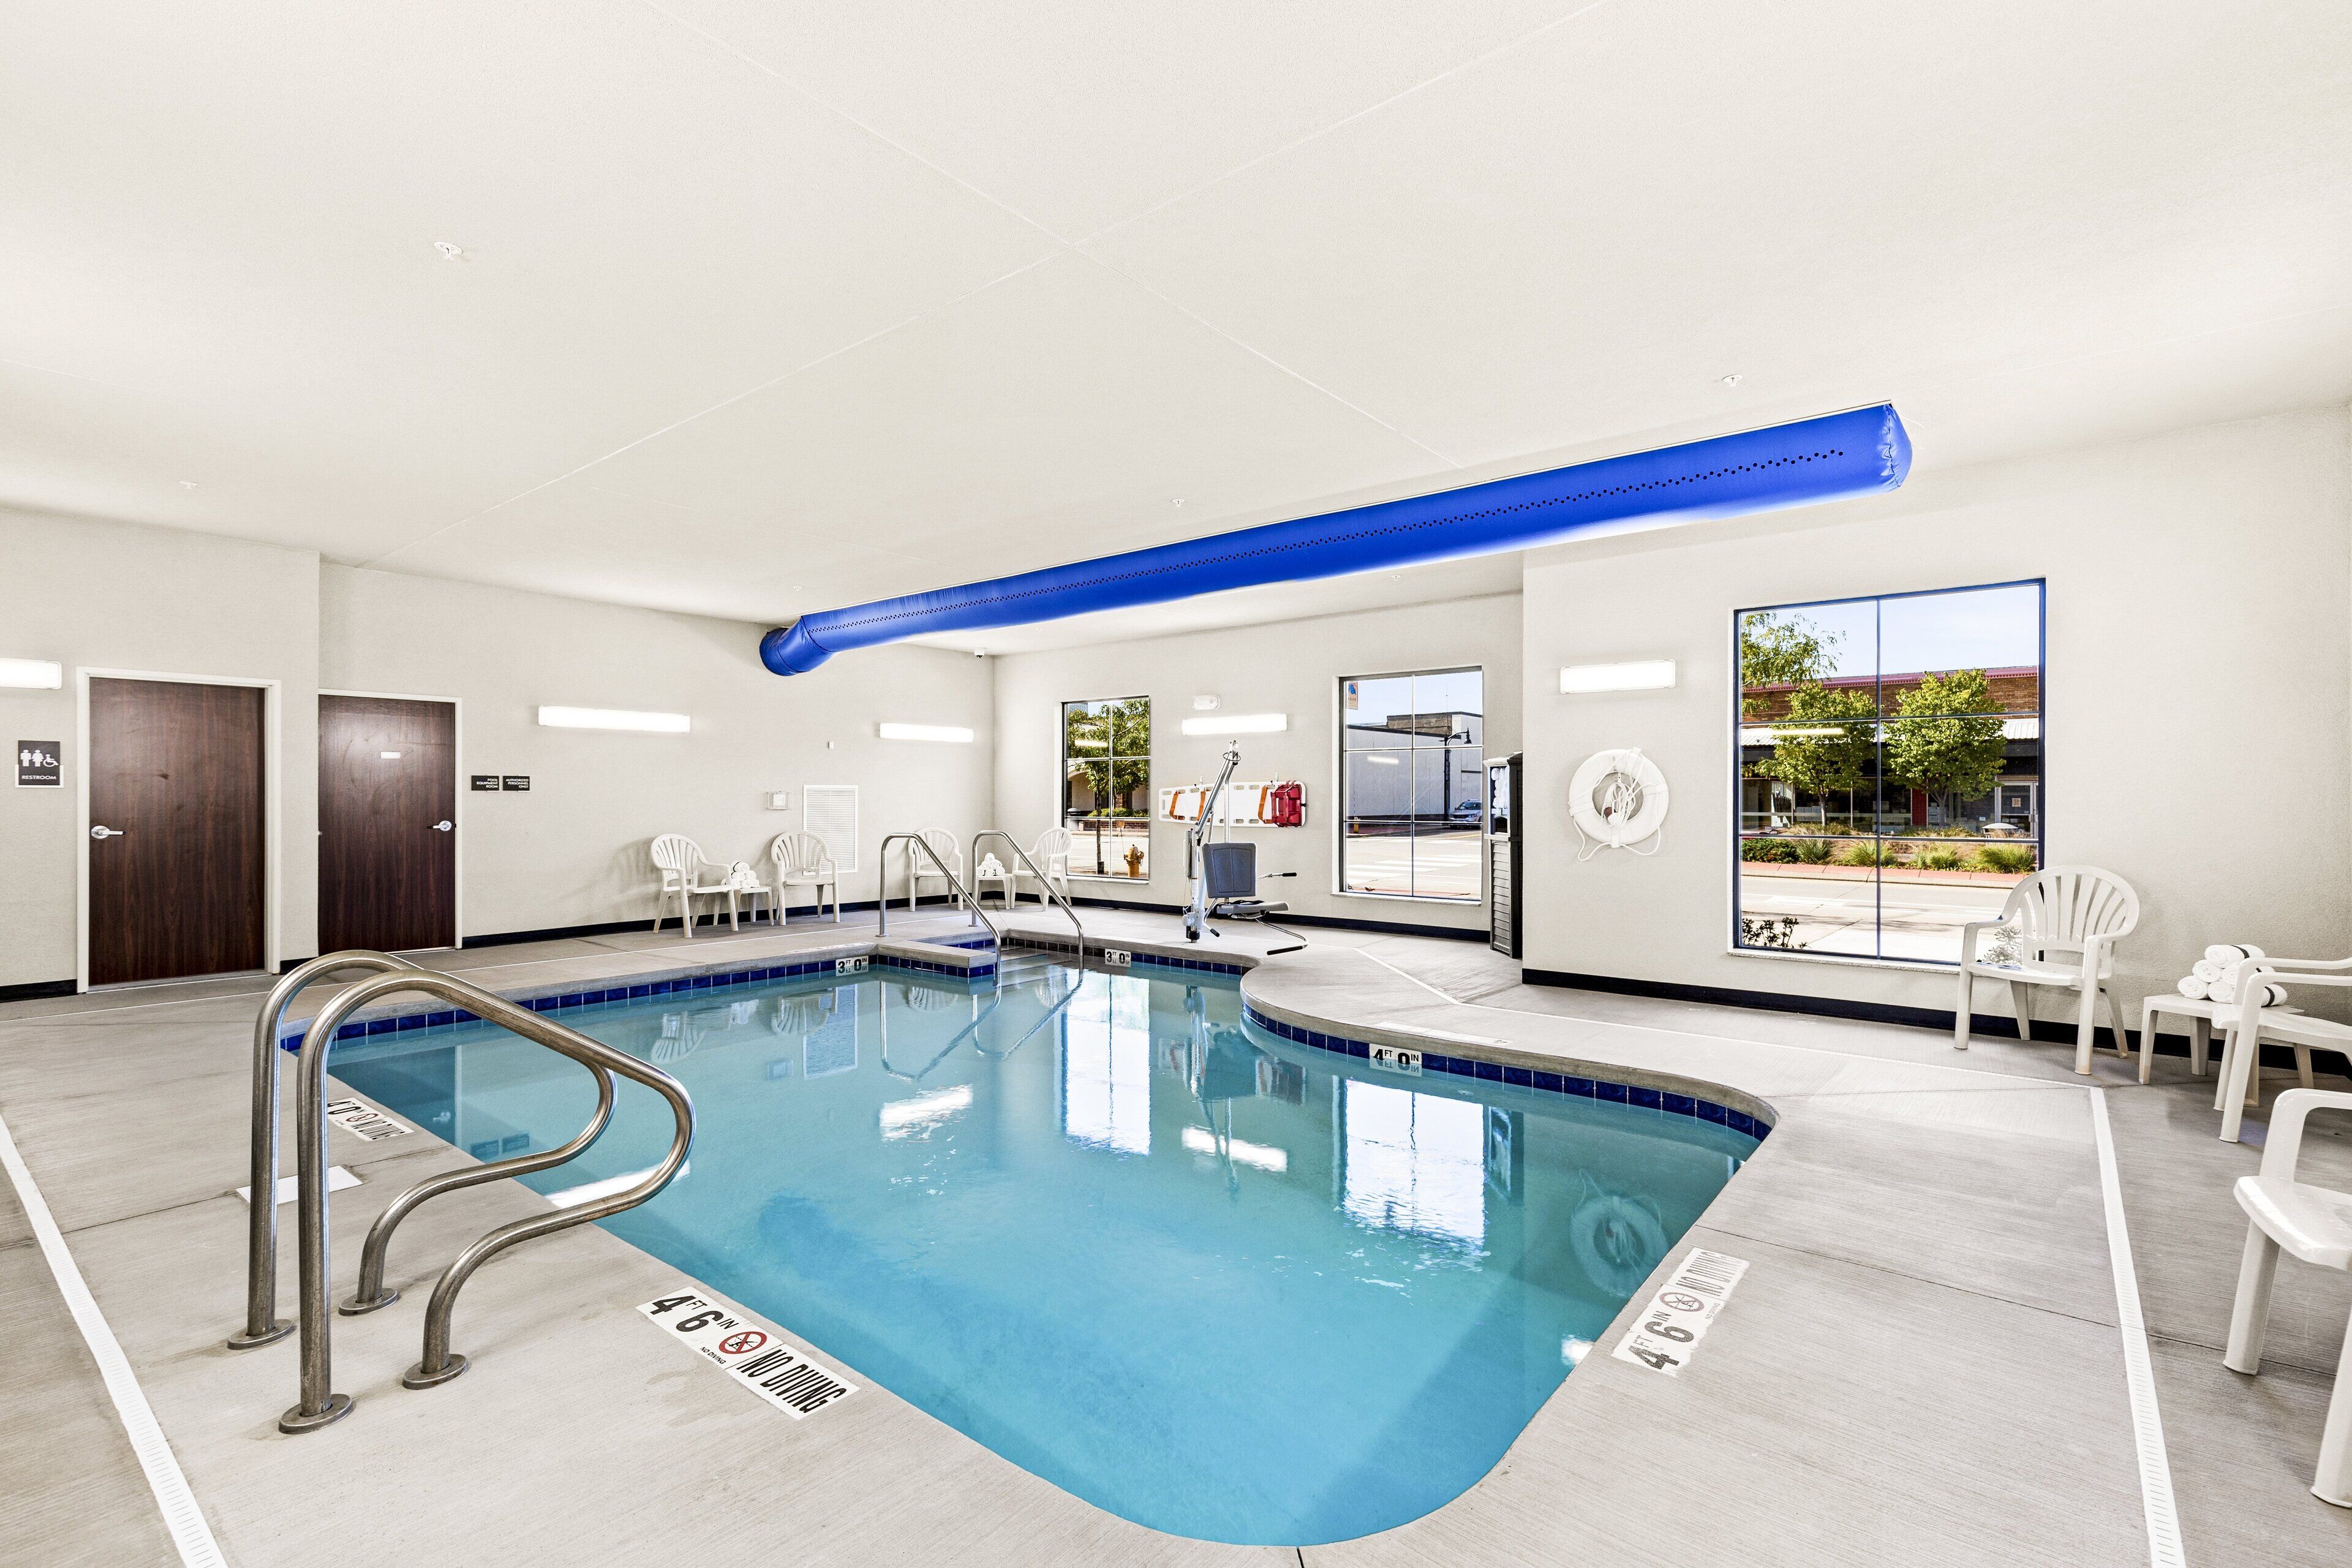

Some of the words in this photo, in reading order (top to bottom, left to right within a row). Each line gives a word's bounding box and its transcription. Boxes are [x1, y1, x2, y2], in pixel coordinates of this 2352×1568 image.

[1106, 951, 1112, 961] 3
[838, 960, 845, 971] 3
[1373, 1049, 1384, 1061] 4
[350, 1118, 387, 1129] NO
[358, 1123, 405, 1140] DIVING
[1686, 1251, 1744, 1283] DIVING
[1676, 1276, 1725, 1297] NO
[650, 1295, 696, 1315] 4
[686, 1300, 708, 1310] FT
[1709, 1303, 1721, 1314] DIVING
[676, 1310, 724, 1332] 6
[1651, 1310, 1672, 1322] IN
[717, 1318, 740, 1329] IN
[1645, 1321, 1694, 1343] 6
[1633, 1335, 1653, 1348] FT
[707, 1352, 726, 1364] DIVING
[736, 1349, 794, 1378] NO
[1628, 1346, 1679, 1370] 4
[760, 1363, 847, 1414] DIVING
